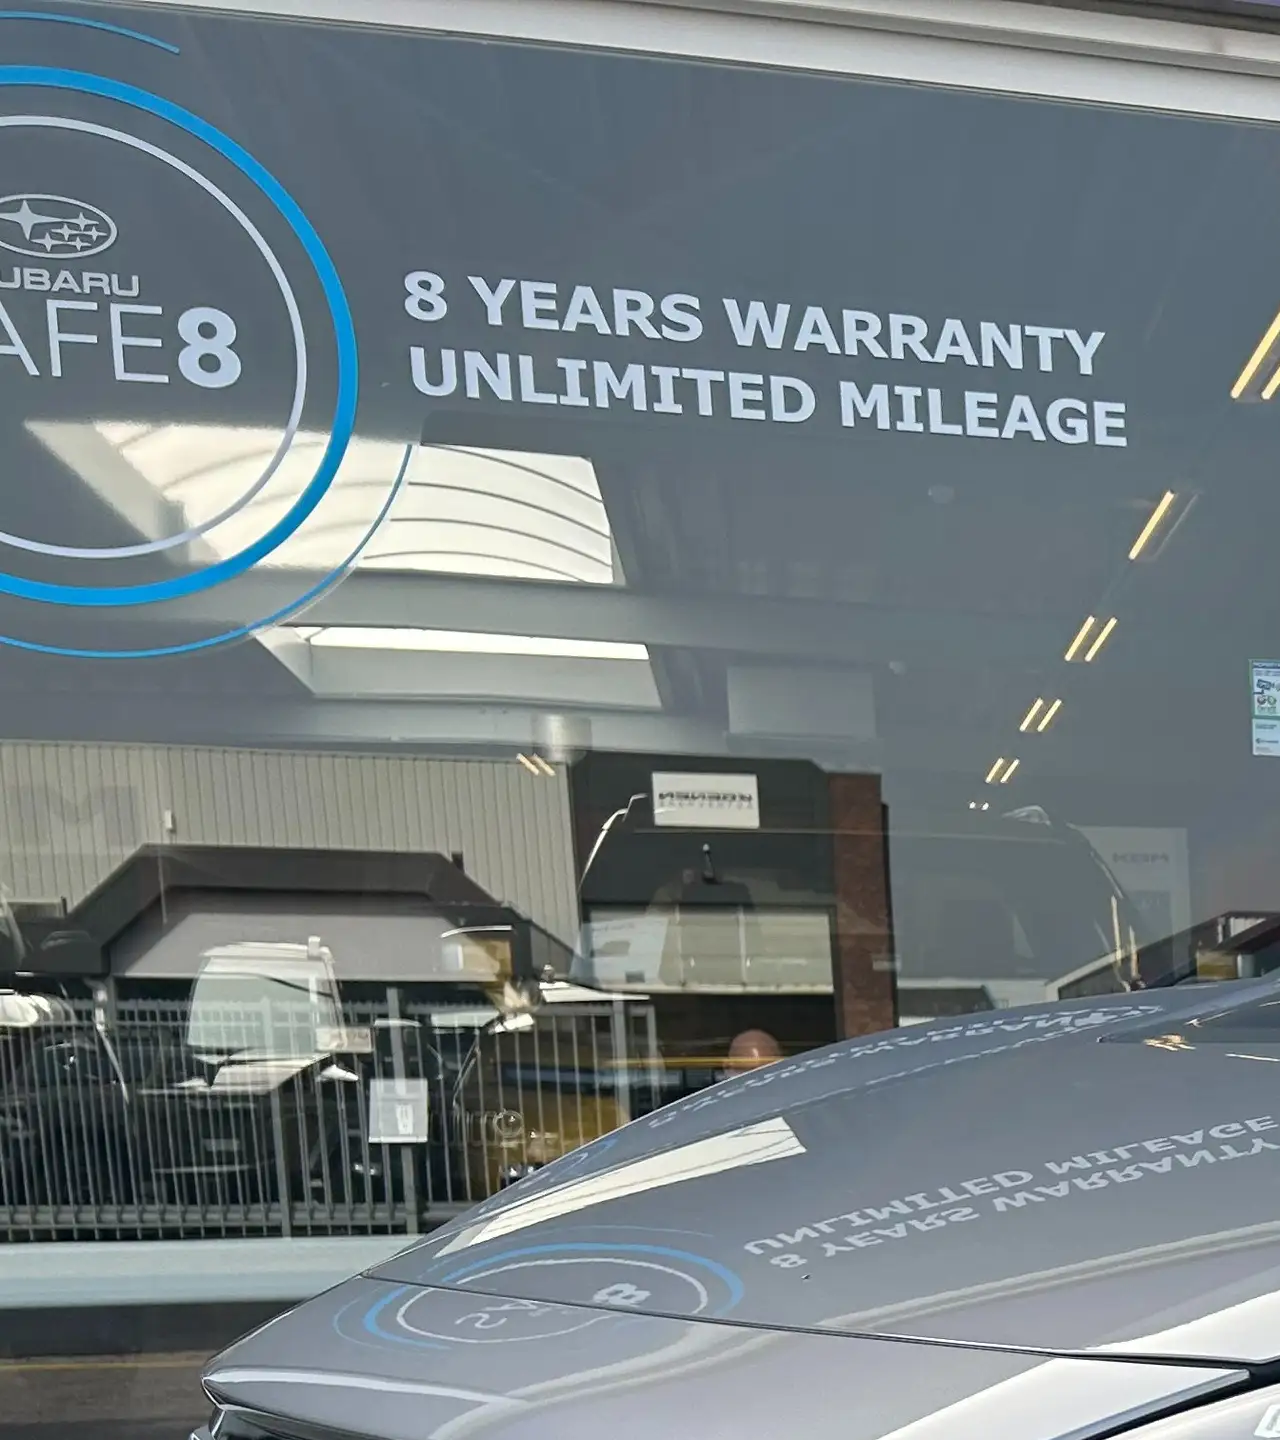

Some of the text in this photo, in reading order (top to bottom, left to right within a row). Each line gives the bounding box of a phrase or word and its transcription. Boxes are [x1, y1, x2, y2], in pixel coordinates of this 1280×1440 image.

[0, 267, 140, 297] UBARU
[403, 270, 1106, 376] 8 YEARS WARRANTY
[0, 298, 242, 388] AFE8
[409, 345, 1128, 447] UNLIMITED MILEAGE
